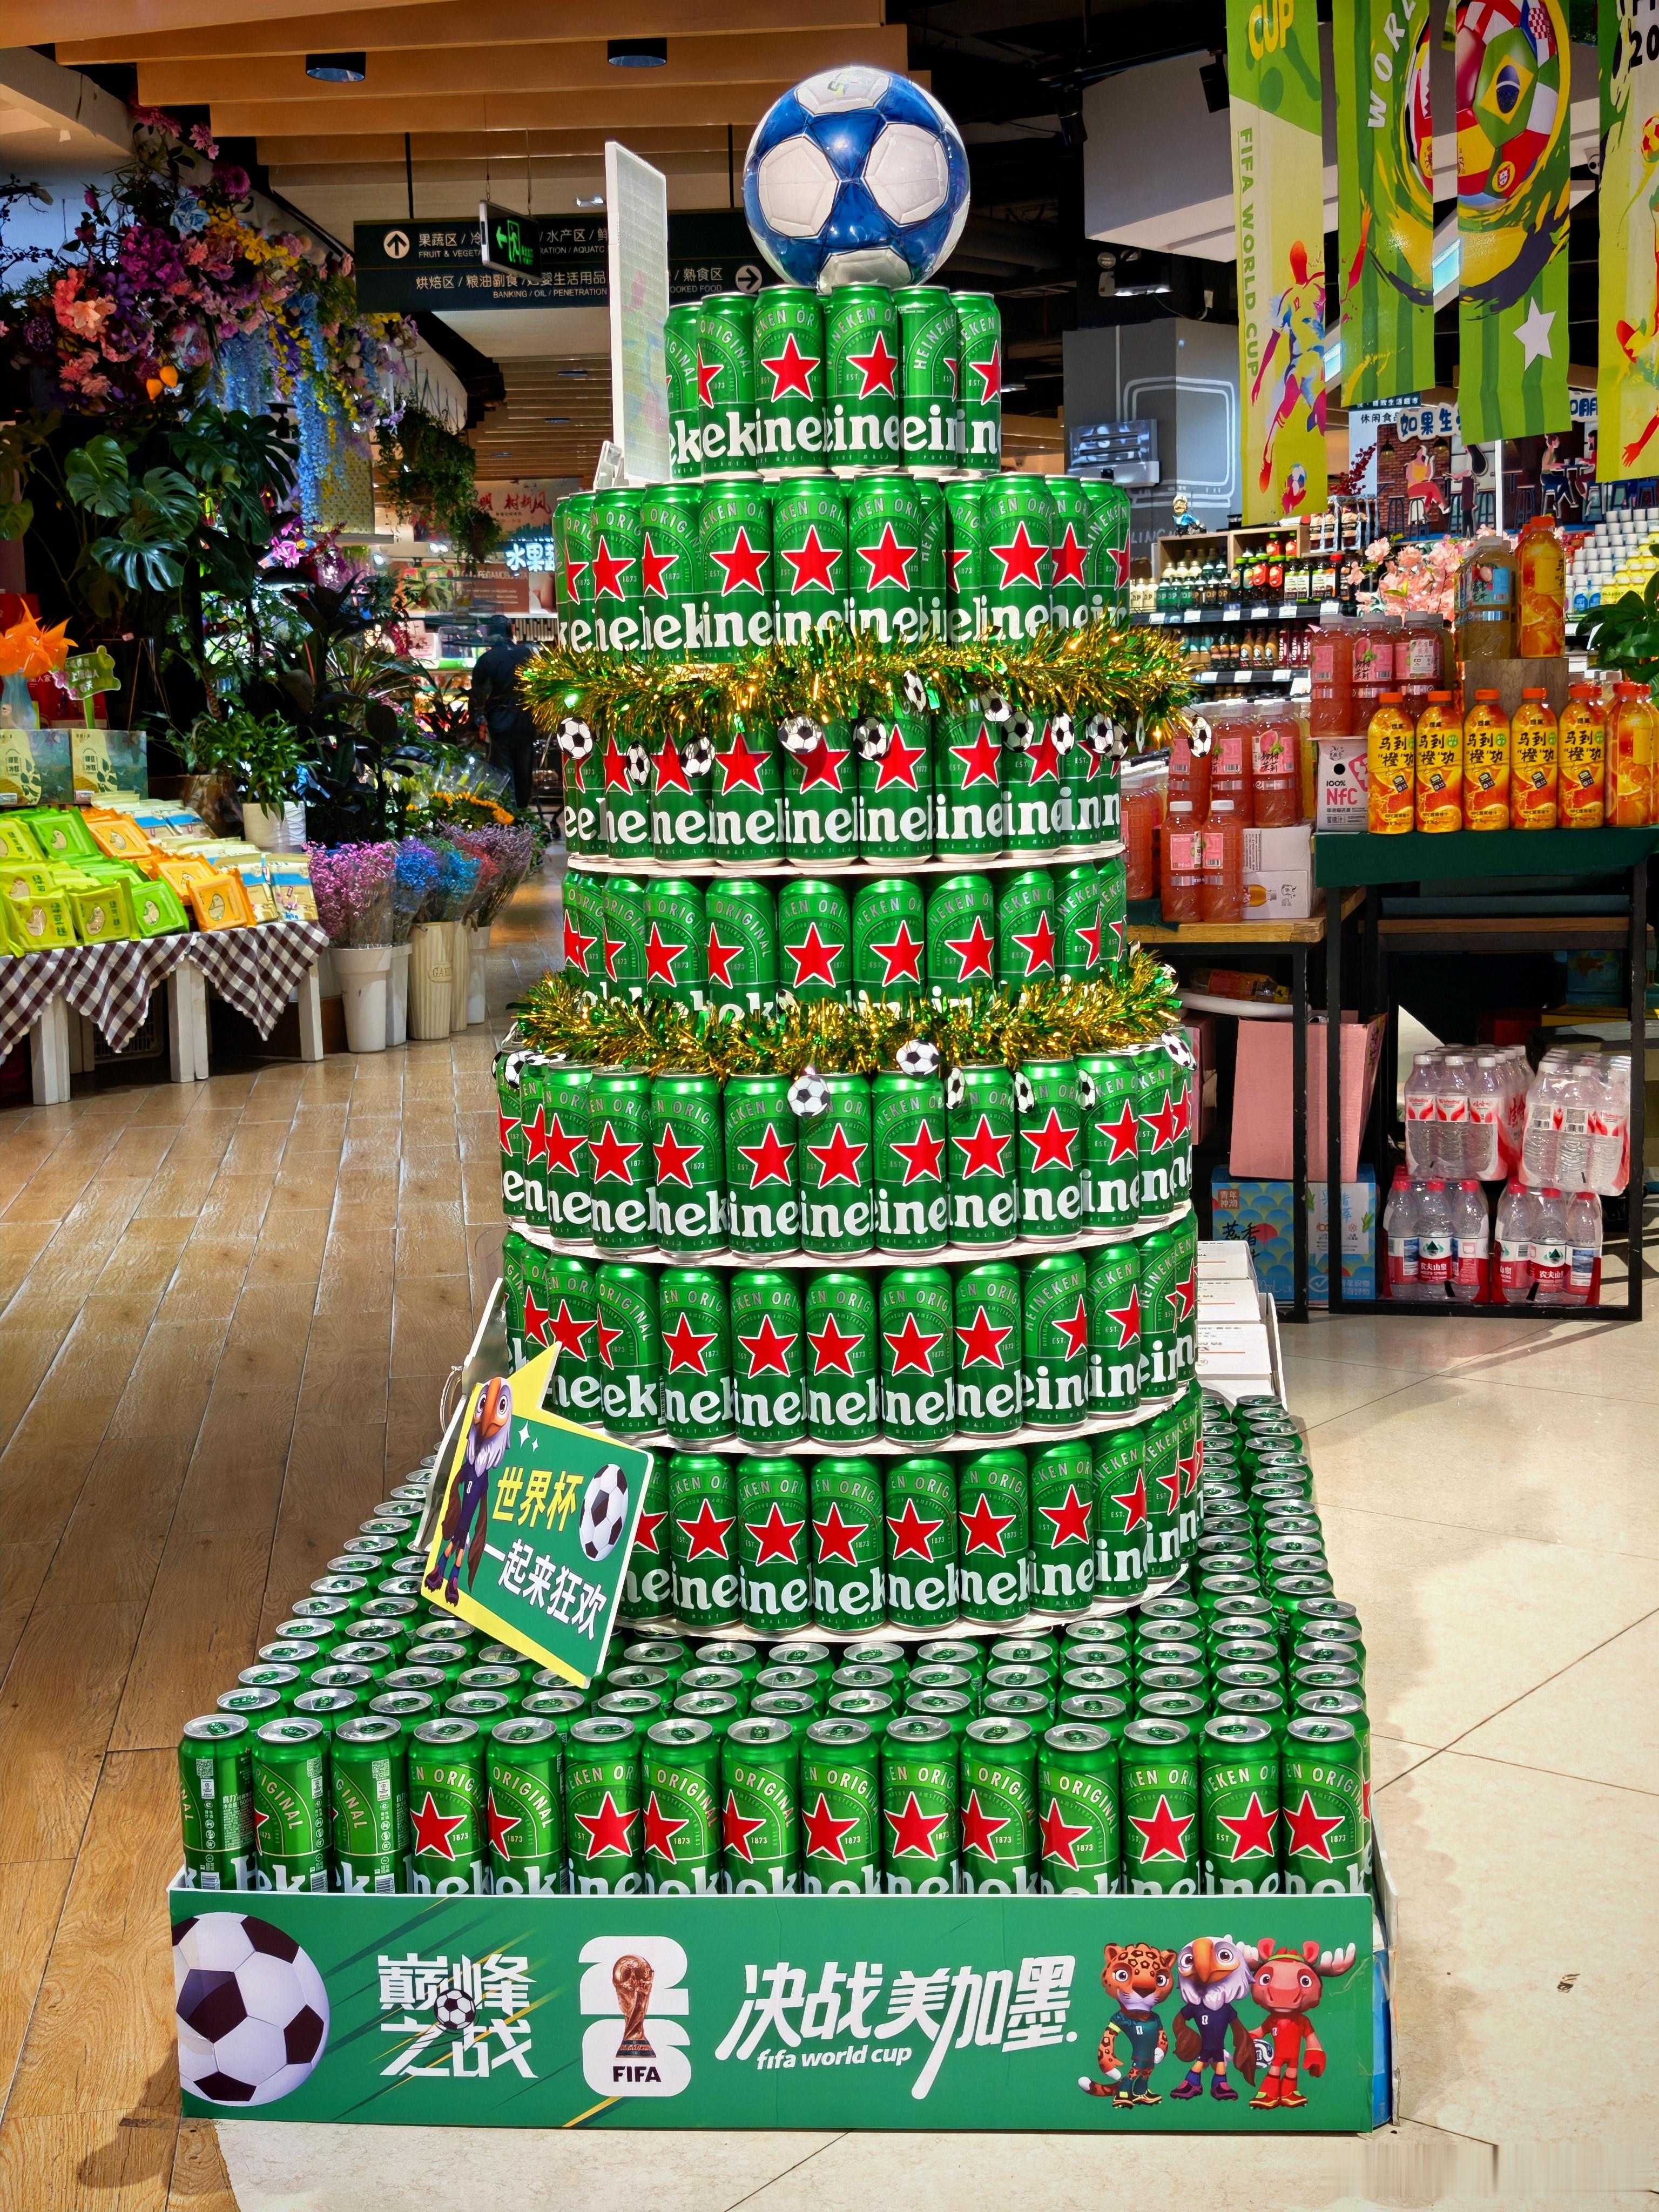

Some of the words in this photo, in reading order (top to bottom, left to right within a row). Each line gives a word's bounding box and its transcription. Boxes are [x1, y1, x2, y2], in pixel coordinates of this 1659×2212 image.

[1249, 0, 1294, 60] CUP
[1240, 127, 1254, 194] FIFA
[419, 233, 457, 247] 果蔬区
[546, 228, 585, 243] 水产区
[1242, 203, 1257, 311] WORLD
[416, 276, 455, 290] 烘焙区
[466, 274, 518, 289] 粮油副食
[683, 267, 724, 282] 熟食区
[554, 288, 607, 297] PENETRATION
[698, 283, 722, 293] FOOD
[1246, 322, 1259, 377] CUP
[1379, 736, 1407, 751] 马到
[1419, 734, 1444, 748] 马到
[1467, 733, 1493, 747] 马到
[1518, 732, 1546, 746] 马到
[1565, 731, 1593, 745] 马到
[1421, 1262, 1447, 1271] 农夫山泉
[1024, 1272, 1078, 1332] HEINEKEN
[599, 1283, 655, 1342] ORIGINAL
[492, 1467, 585, 1532] 世界杯
[483, 1538, 608, 1641] 一起来狂欢
[493, 1766, 556, 1829] ORIGINAL
[734, 1768, 797, 1829] ORIGINAL
[844, 1836, 861, 1845] 1873
[995, 1836, 1012, 1844] 1873
[377, 1952, 537, 2017] 巅峰
[379, 2015, 539, 2079] 之战
[757, 2048, 796, 2070] fifa
[801, 2045, 867, 2068] world
[871, 2047, 912, 2067] cup
[612, 2066, 662, 2082] FIFA
